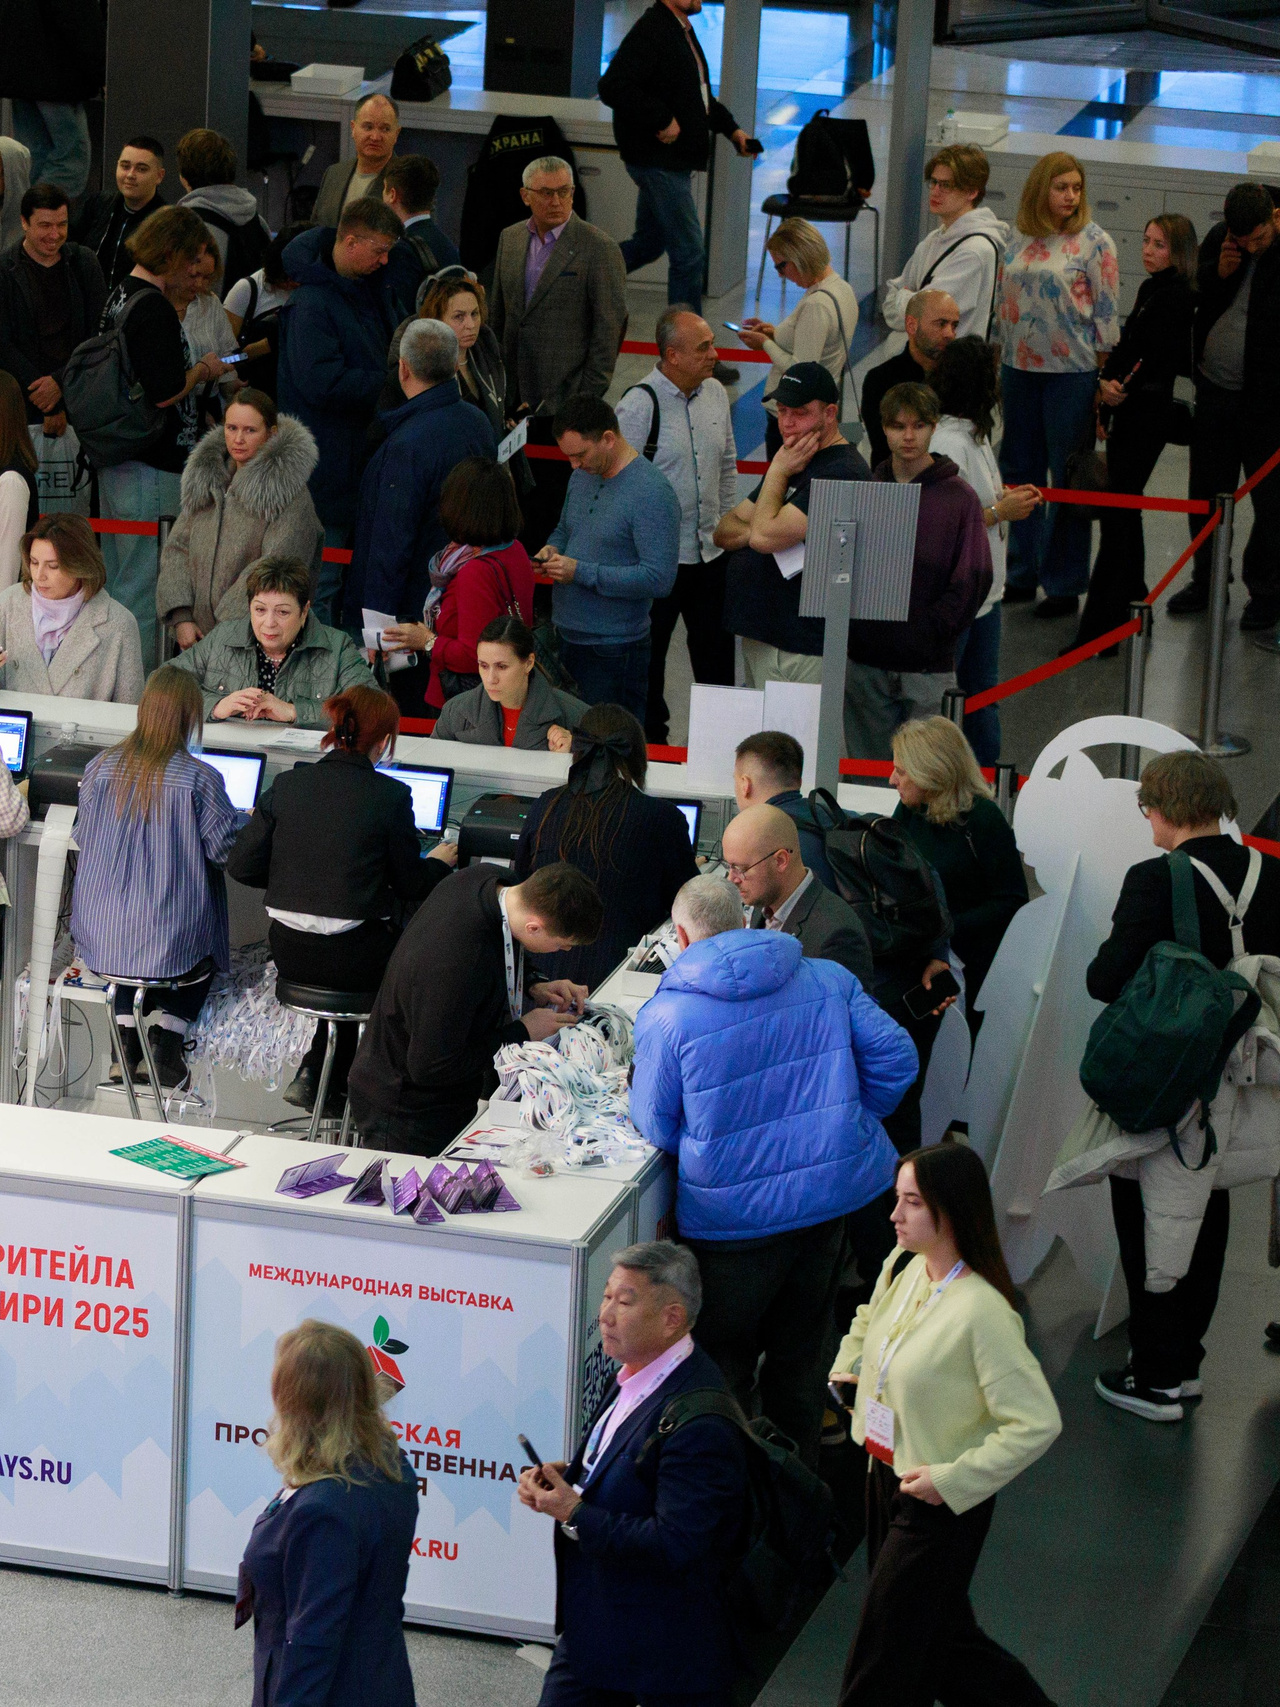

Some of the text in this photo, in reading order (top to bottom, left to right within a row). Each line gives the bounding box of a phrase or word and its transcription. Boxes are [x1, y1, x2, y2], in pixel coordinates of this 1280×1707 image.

[248, 1263, 515, 1312] МЕЖДУНАРОДНАЯ ВЫСТАВКА
[74, 1300, 150, 1338] 2025
